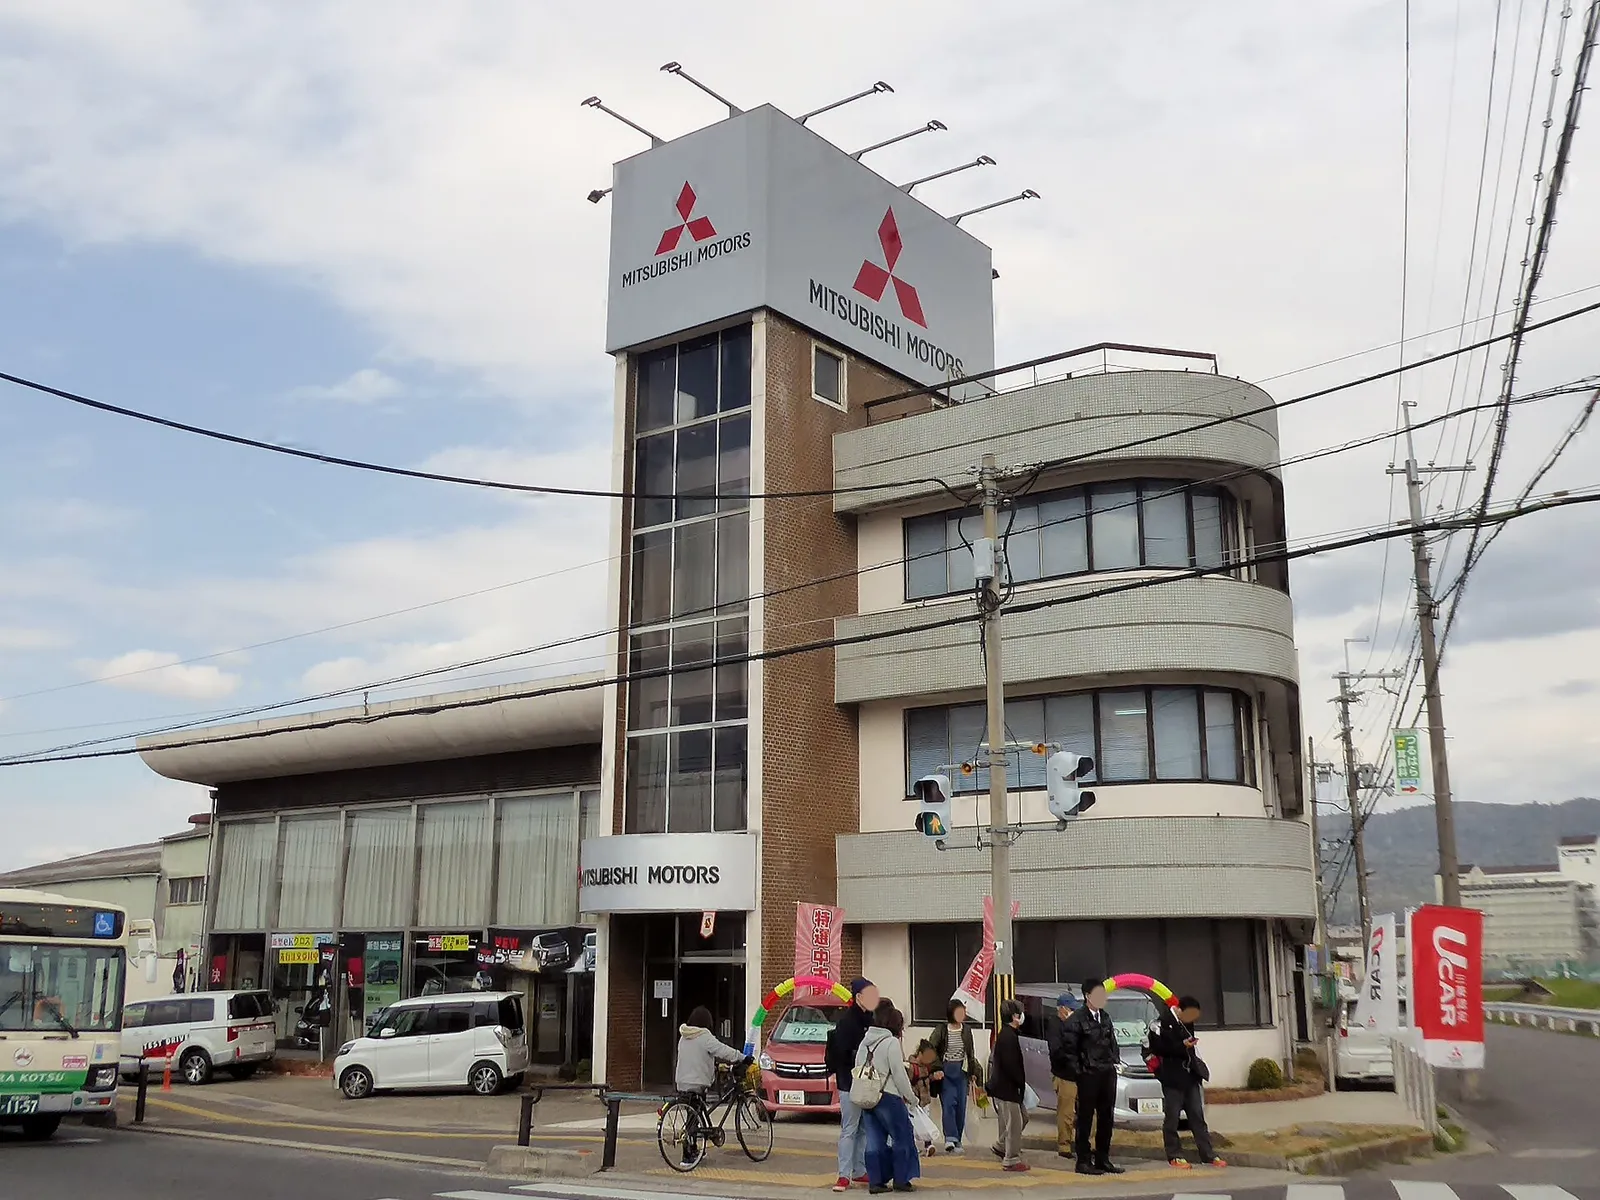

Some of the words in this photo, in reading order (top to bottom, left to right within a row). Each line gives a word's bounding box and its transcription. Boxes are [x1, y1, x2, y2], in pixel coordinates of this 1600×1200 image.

[622, 251, 693, 288] MITSUBISHI
[697, 232, 752, 263] MOTORS
[809, 278, 901, 349] MITSUBISHI
[906, 331, 966, 380] MOTORS
[648, 866, 720, 885] MOTORS
[495, 936, 519, 949] NEW
[792, 1027, 818, 1036] 972
[143, 1039, 163, 1051] TEST
[19, 1072, 66, 1083] KOTSU
[6, 1099, 39, 1115] 11-57
